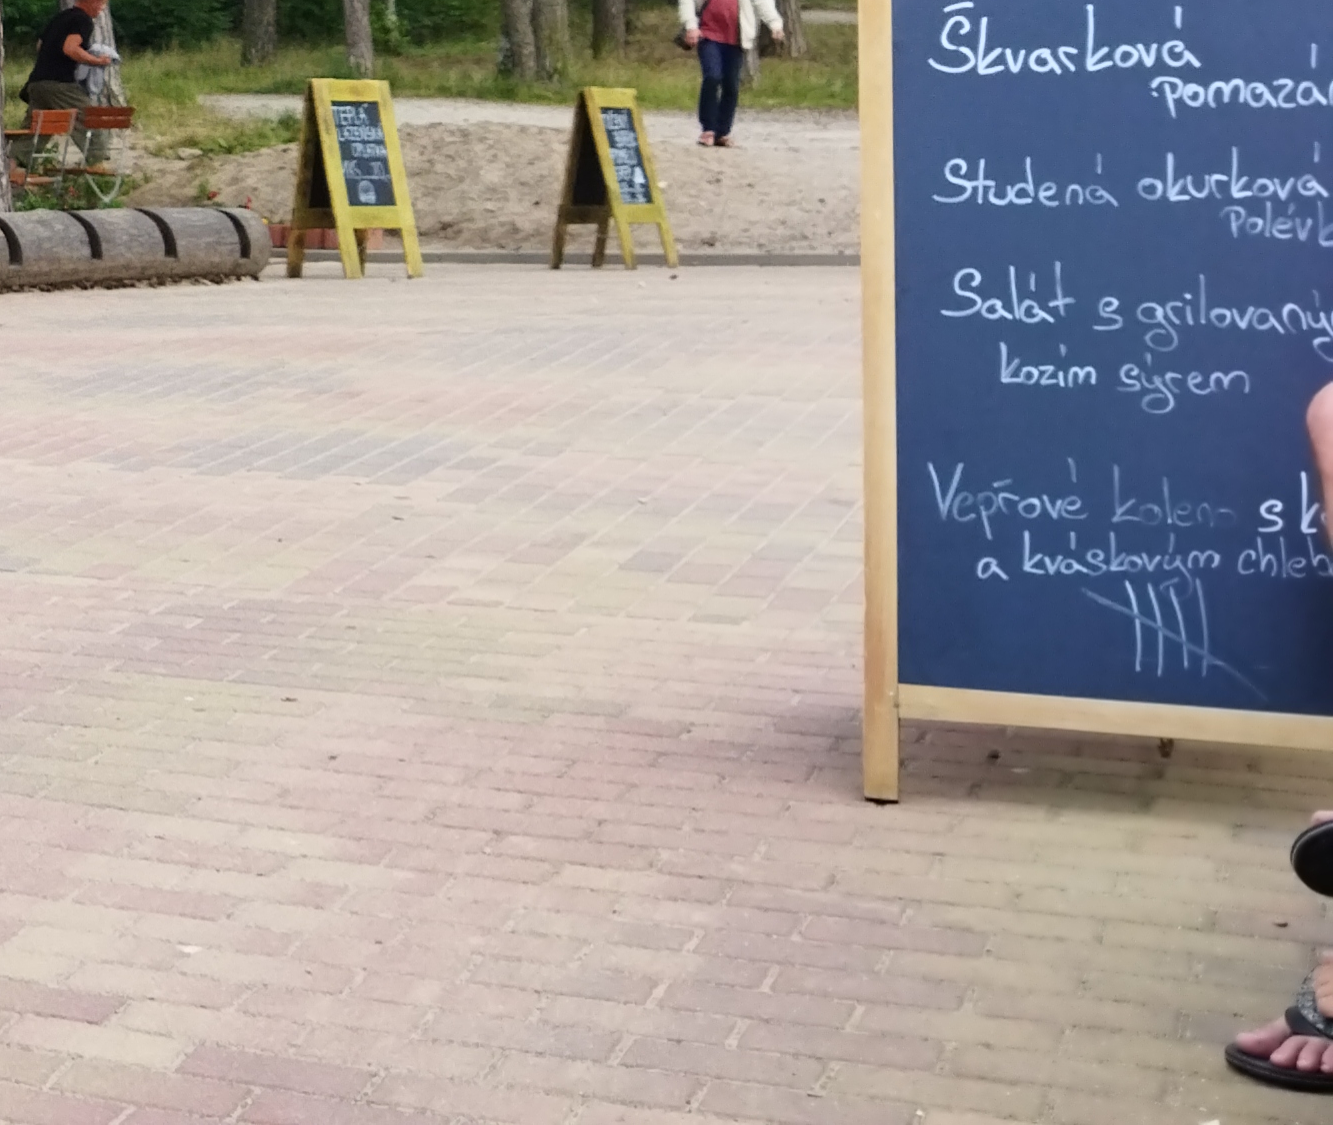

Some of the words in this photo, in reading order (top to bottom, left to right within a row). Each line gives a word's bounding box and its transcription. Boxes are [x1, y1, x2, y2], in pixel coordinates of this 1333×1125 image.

[928, 0, 1201, 75] Škvarková
[932, 153, 1119, 208] Studená
[1137, 141, 1329, 202] okurková
[940, 261, 1076, 324] Salát
[1093, 297, 1123, 331] s
[1117, 352, 1250, 414] sýrem
[928, 457, 1089, 540] Vepřové
[1257, 499, 1286, 533] s
[977, 557, 1010, 581] a
